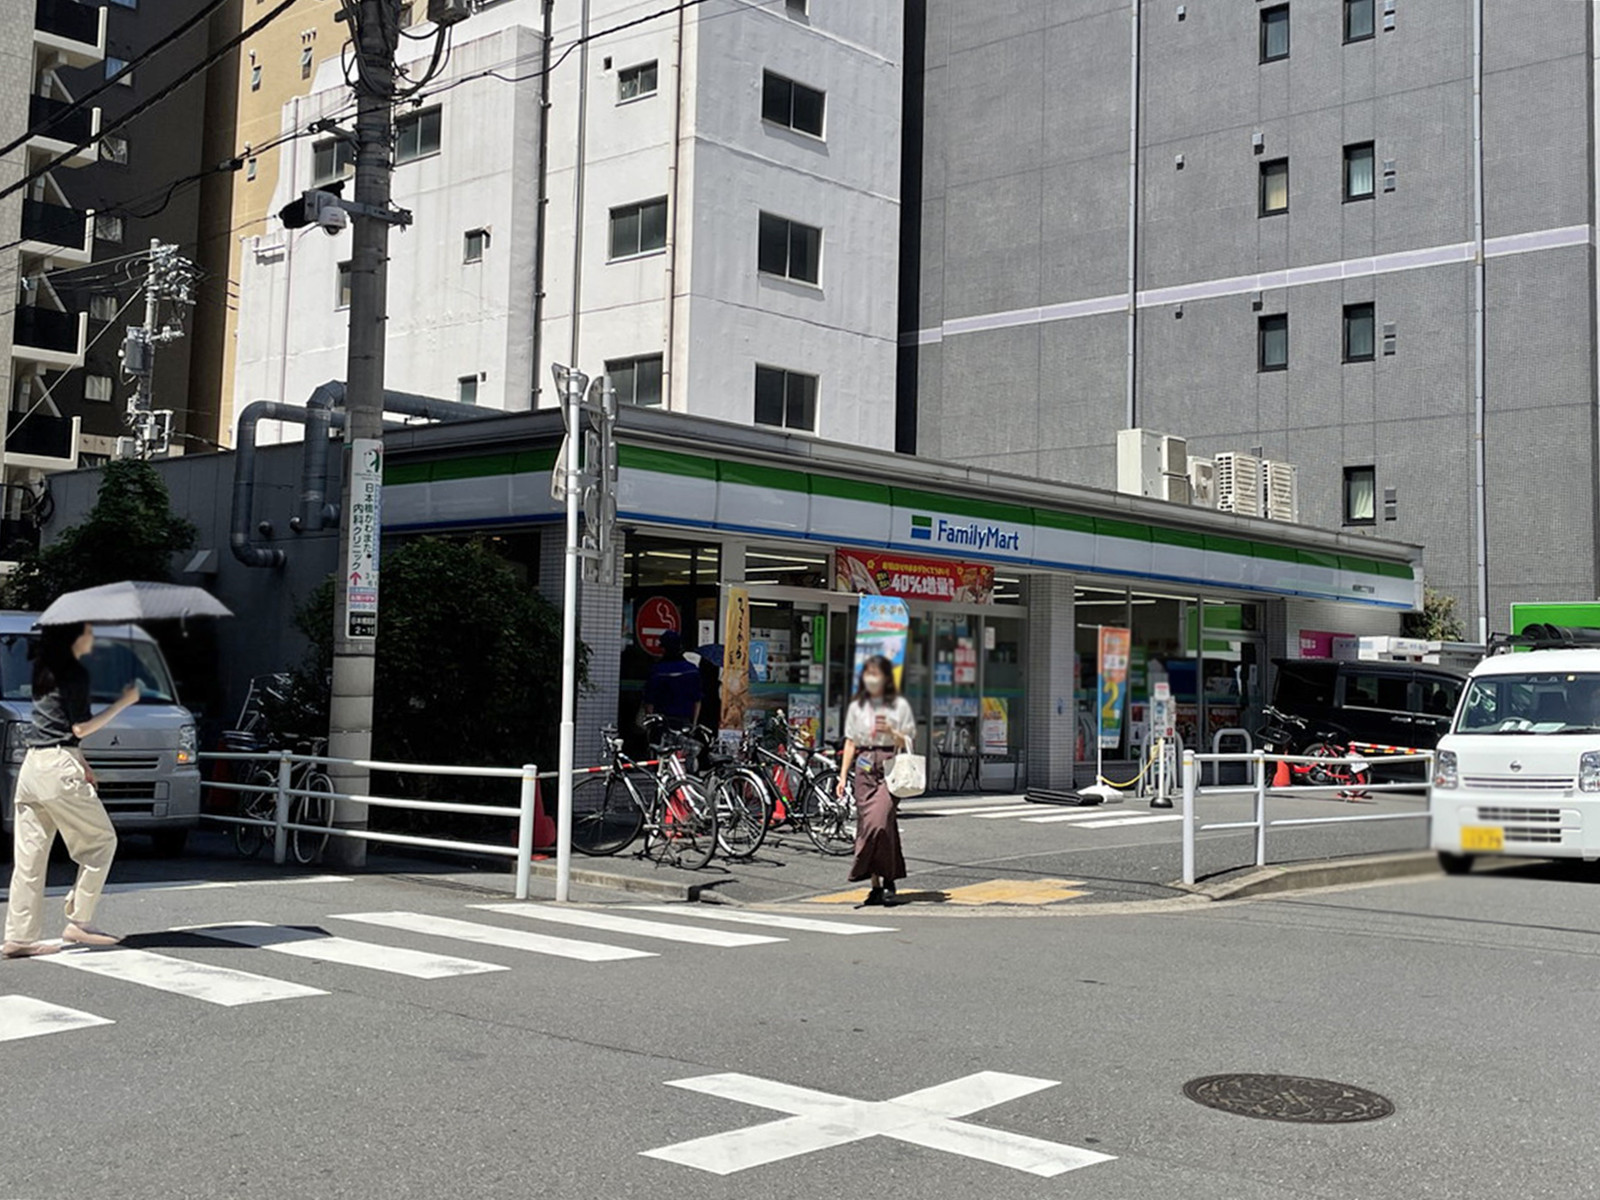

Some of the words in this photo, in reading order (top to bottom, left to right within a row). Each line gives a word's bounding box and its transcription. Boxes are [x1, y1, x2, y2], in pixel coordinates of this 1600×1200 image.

[352, 503, 364, 570] 内科クリニック
[937, 519, 1019, 550] FamilyMart
